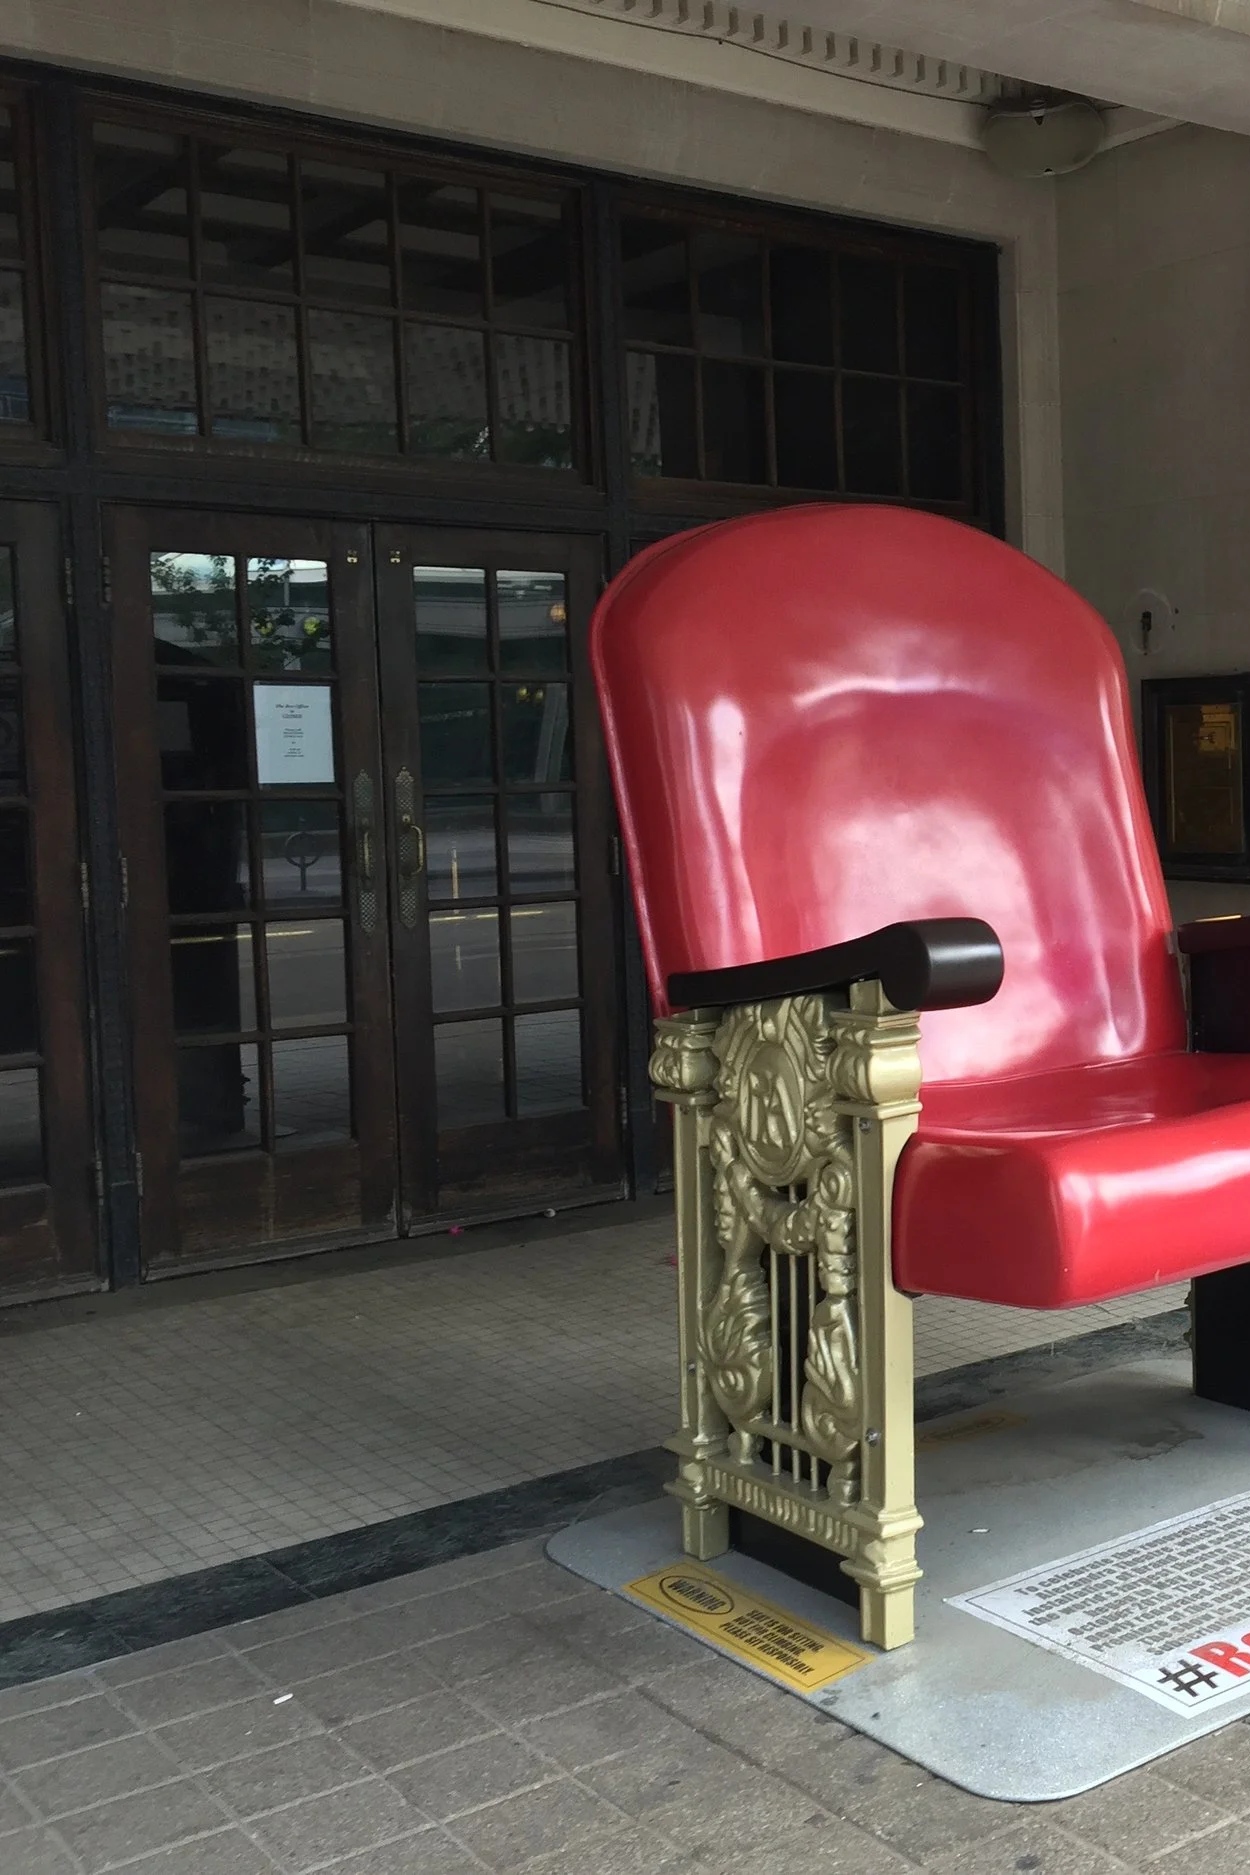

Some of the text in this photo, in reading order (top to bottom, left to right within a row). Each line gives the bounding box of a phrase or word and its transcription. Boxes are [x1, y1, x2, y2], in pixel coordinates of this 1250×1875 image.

[1013, 1585, 1040, 1595] To
[1038, 1558, 1114, 1587] celebrate
[1110, 1548, 1141, 1560] the
[1138, 1519, 1217, 1550] renovation
[1210, 1513, 1232, 1522] of
[1022, 1579, 1117, 1616] installation
[1130, 1554, 1179, 1575] brand
[1176, 1543, 1211, 1558] new
[1028, 1612, 1060, 1626] the
[1114, 1568, 1174, 1592] largest
[1170, 1547, 1228, 1571] theatre
[1035, 1568, 1117, 1600] Alexandra
[1174, 1529, 1221, 1547] which
[1082, 1594, 1138, 1617] began
[1132, 1588, 1156, 1598] in
[1149, 1574, 1191, 1590] May
[1184, 1562, 1217, 1578] and
[1212, 1551, 1248, 1566] will
[667, 1579, 728, 1611] WARNING
[1067, 1607, 1134, 1636] October
[1171, 1579, 1206, 1594] The
[1201, 1566, 1240, 1582] first
[1084, 1619, 1139, 1643] newly
[1133, 1588, 1214, 1622] renovated
[1089, 1620, 1168, 1652] Premiere
[1182, 1601, 1214, 1615] the
[1210, 1587, 1246, 1604] new
[1136, 1631, 1173, 1646] The
[1170, 1613, 1215, 1633] show
[1146, 1612, 1250, 1655] Subscription
